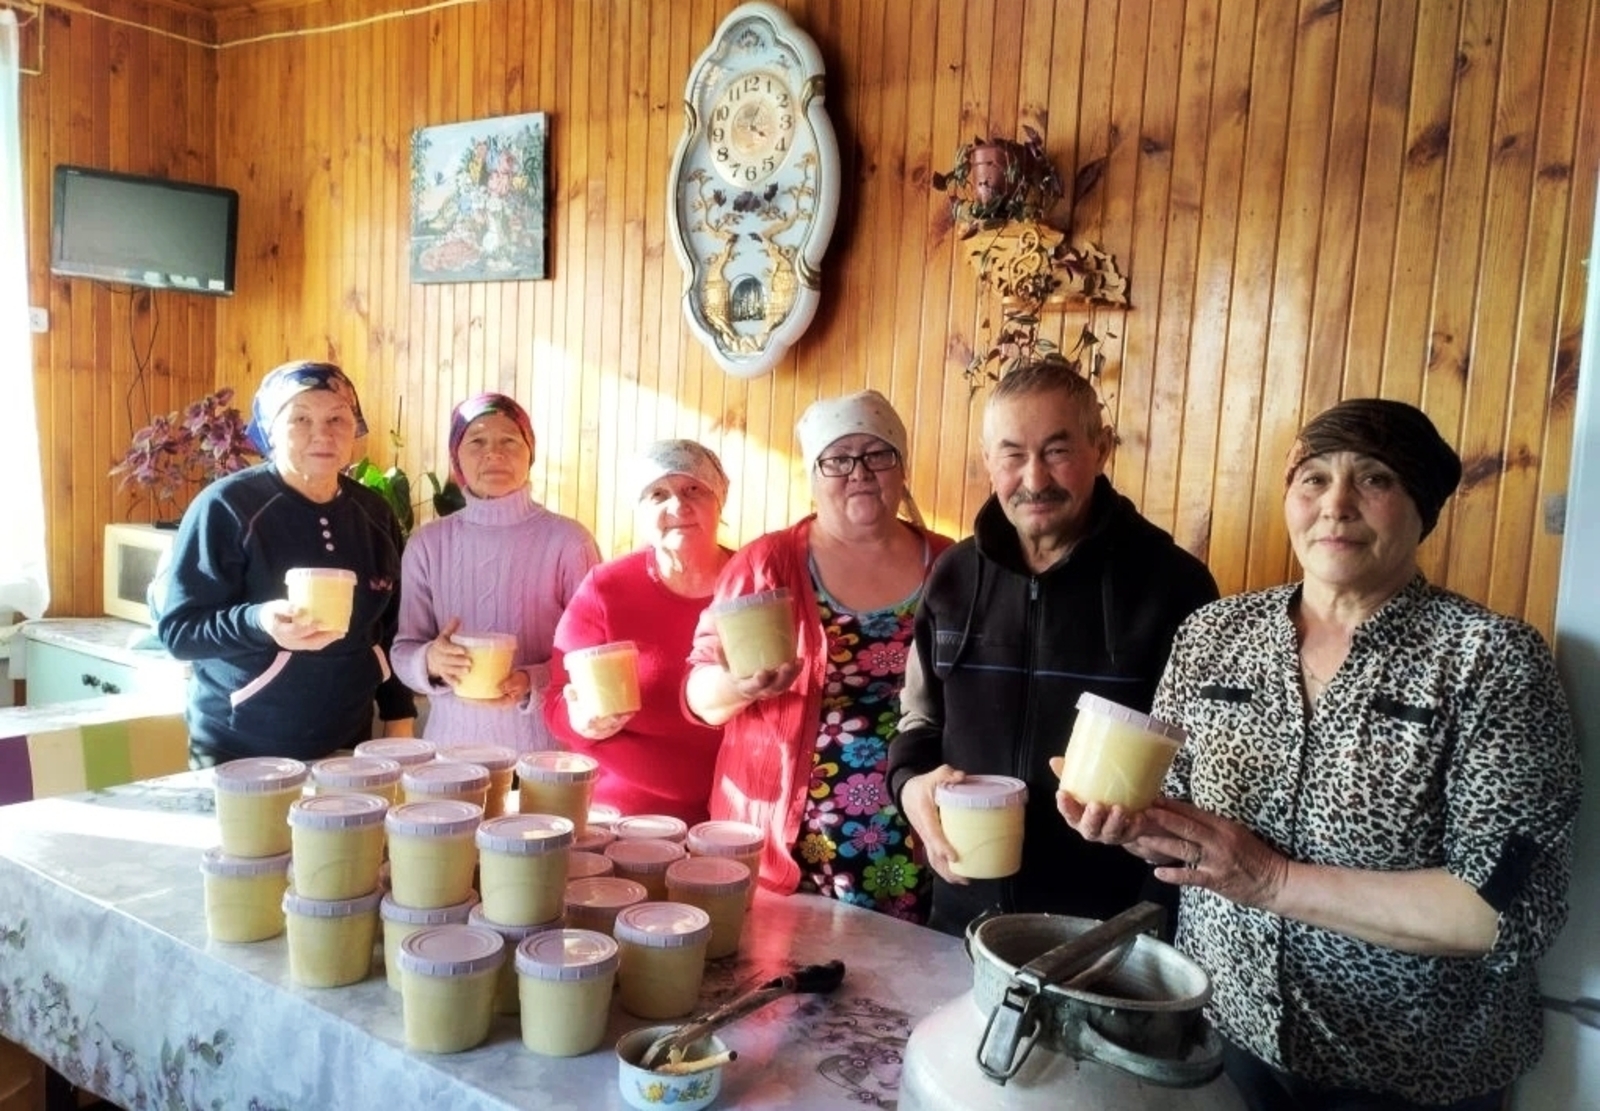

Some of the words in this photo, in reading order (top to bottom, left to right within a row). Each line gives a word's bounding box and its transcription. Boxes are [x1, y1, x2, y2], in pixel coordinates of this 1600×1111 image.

[744, 76, 760, 93] 12
[729, 87, 740, 101] 11
[776, 93, 789, 108] 2
[716, 105, 729, 121] 10
[780, 114, 792, 130] 3
[713, 128, 725, 143] 9
[775, 137, 786, 151] 4
[717, 147, 729, 162] 8
[729, 163, 741, 178] 7
[762, 156, 774, 171] 5
[745, 166, 757, 181] 6
